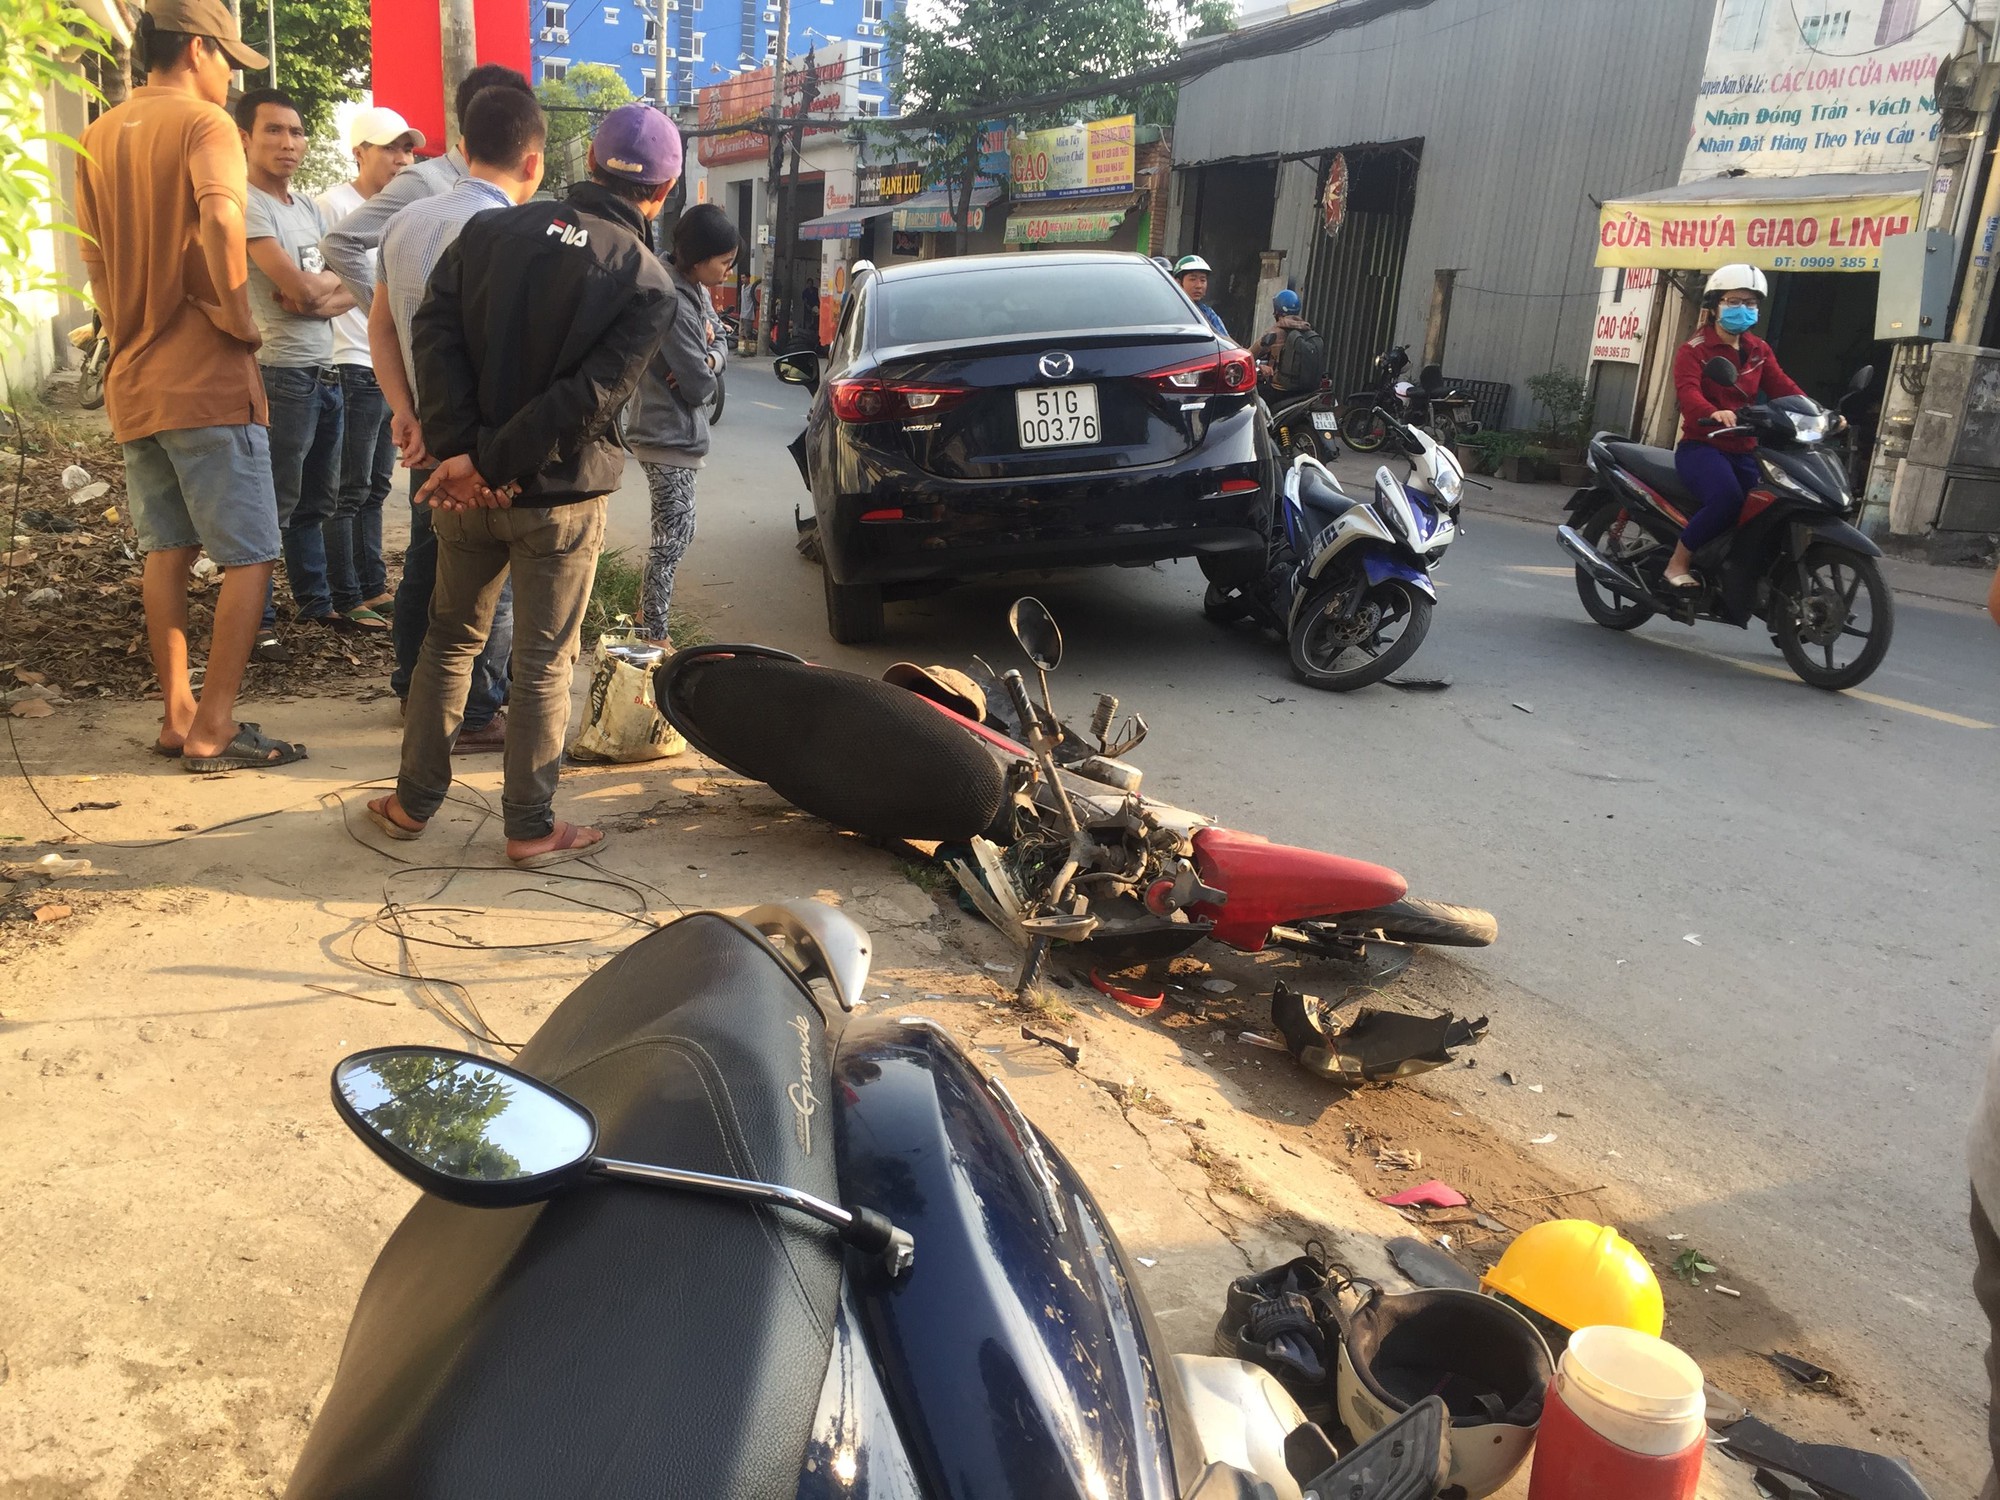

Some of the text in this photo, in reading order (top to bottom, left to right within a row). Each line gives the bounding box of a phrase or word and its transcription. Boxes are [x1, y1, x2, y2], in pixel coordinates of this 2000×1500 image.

[1770, 65, 1803, 94] CÁC
[1806, 66, 1844, 95] LOẠI
[1848, 57, 1882, 88] CỬA
[1886, 52, 1938, 87] NHỰA
[1704, 106, 1749, 130] Nhận
[1755, 103, 1802, 126] Đóng
[1869, 96, 1911, 116] Vách
[1697, 135, 1734, 157] Nhận
[1770, 132, 1808, 153] Hàng
[1814, 131, 1847, 149] Theo
[1853, 127, 1881, 146] Yêu
[546, 218, 589, 248] FILA
[1601, 211, 1910, 253] CỬA NHỰA GIAO LINH
[1774, 257, 1796, 268] ĐT:
[1800, 257, 1835, 268] 0909
[1839, 257, 1867, 268] 385
[1594, 345, 1608, 357] 0909
[1036, 390, 1078, 416] 51G
[1022, 416, 1097, 443] 003.76
[787, 1015, 822, 1156] Grande
